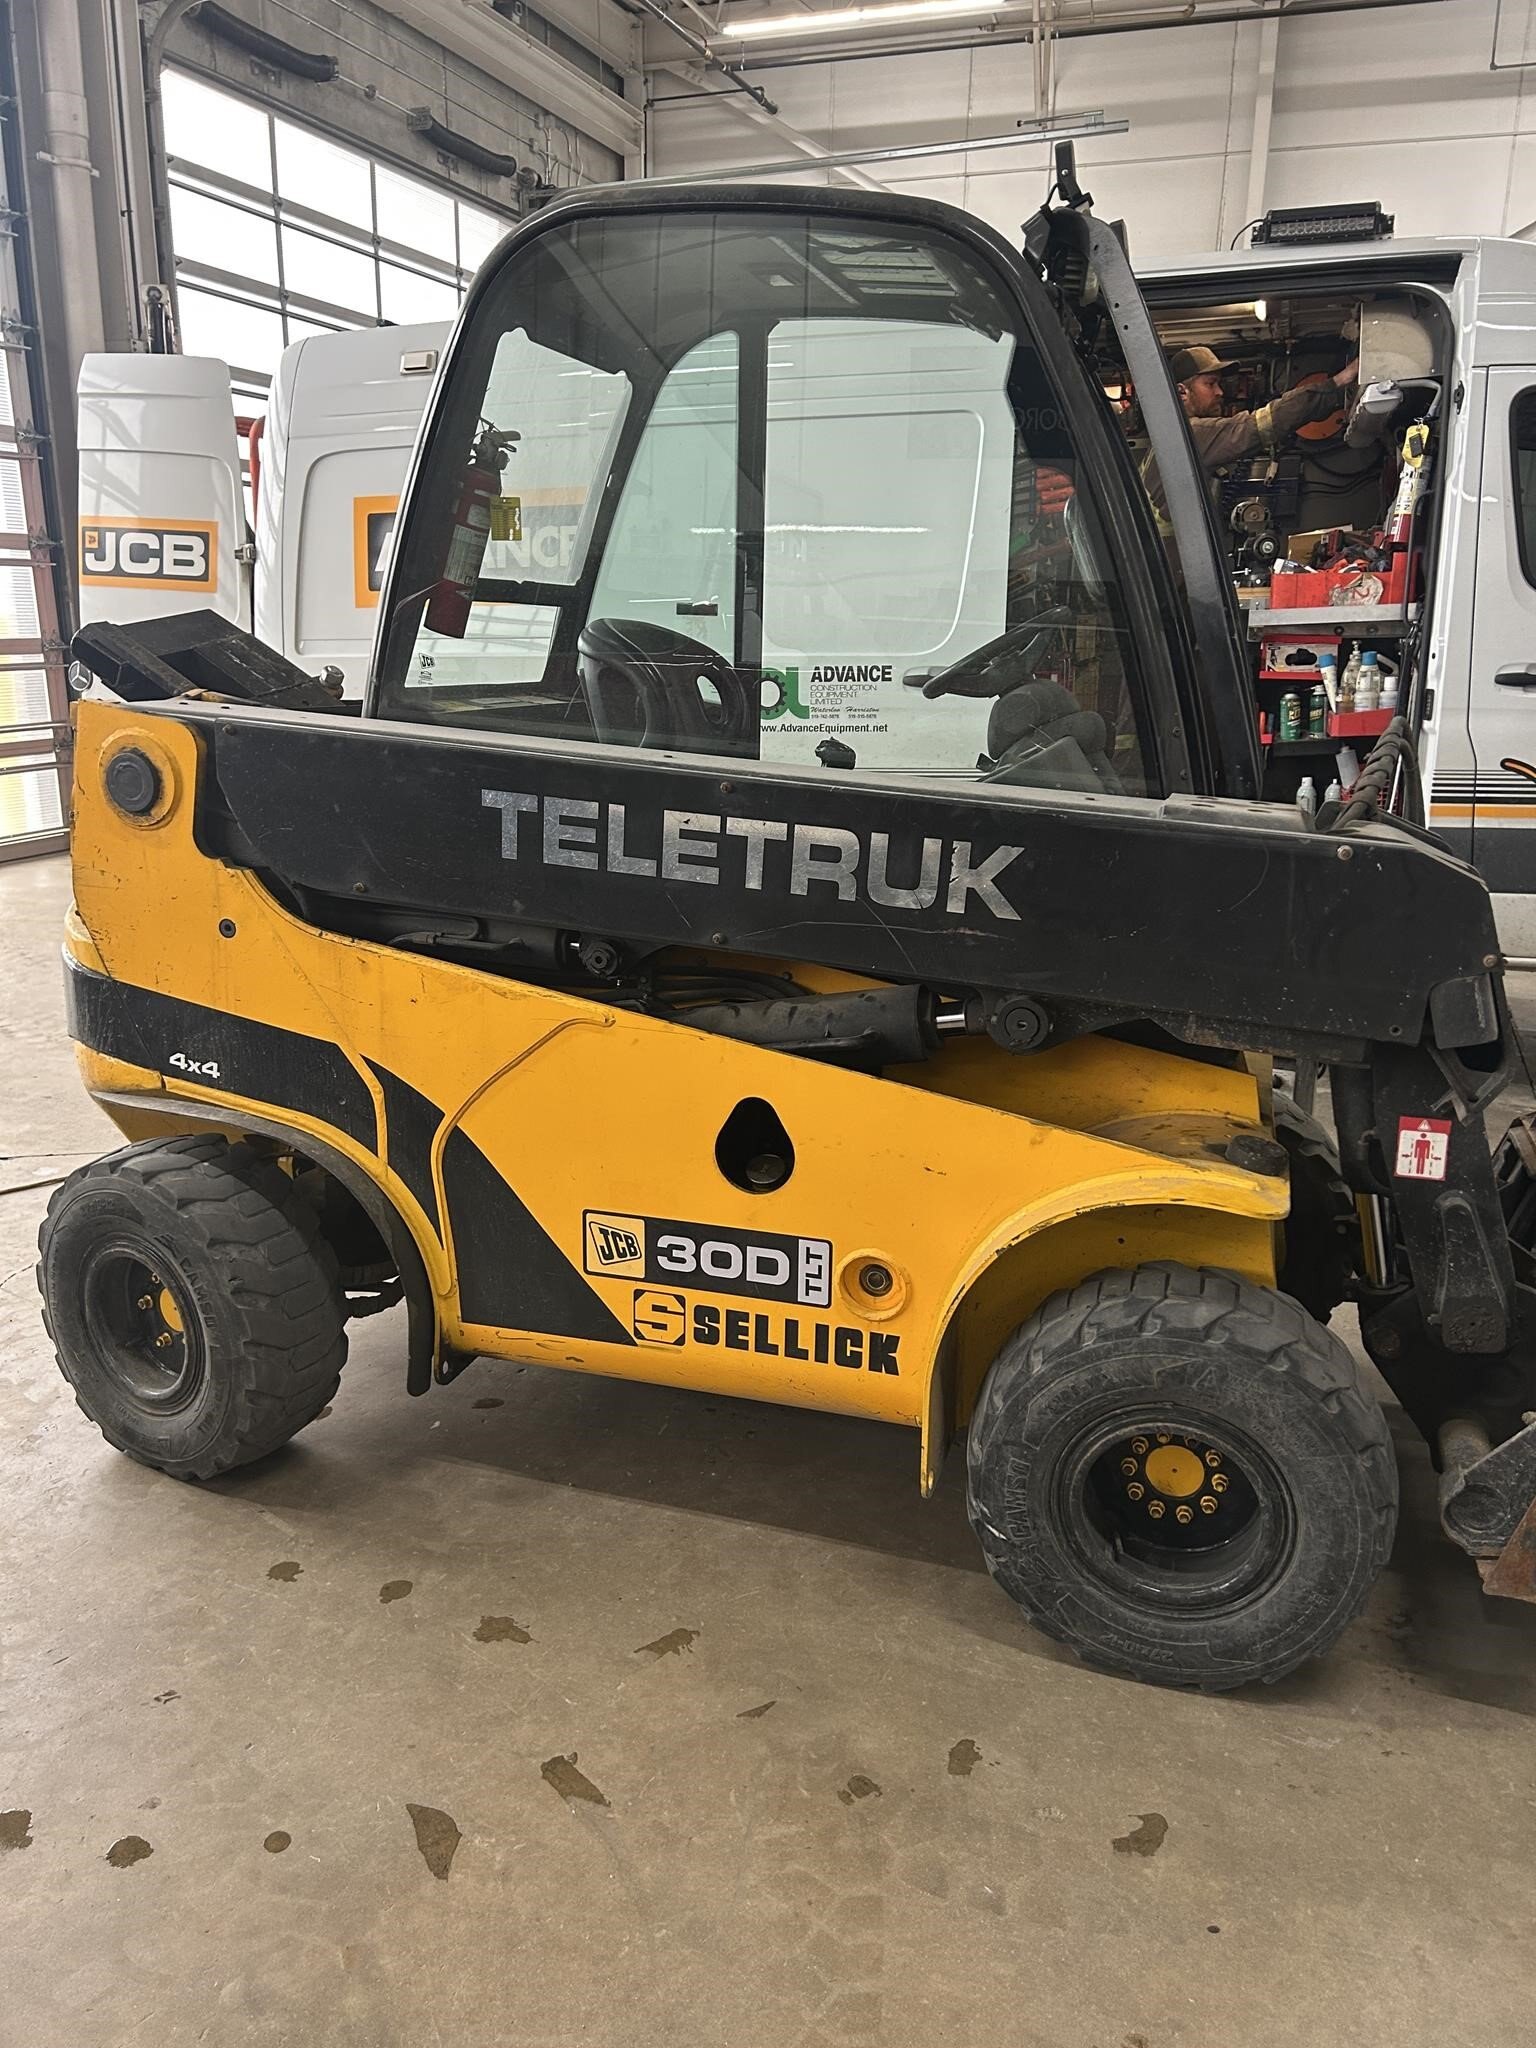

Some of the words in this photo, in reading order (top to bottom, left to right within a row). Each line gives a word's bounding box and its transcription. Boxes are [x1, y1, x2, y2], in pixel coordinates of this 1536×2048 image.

[84, 531, 206, 577] JCB
[810, 665, 893, 682] ADVANCE
[481, 788, 1025, 921] TELETRUK
[168, 1051, 222, 1080] 4x4
[597, 1227, 639, 1261] JCB
[656, 1234, 791, 1287] 30D
[804, 1246, 823, 1297] TLT
[693, 1304, 902, 1377] SELLICK
[1004, 1457, 1032, 1541] CAMSO
